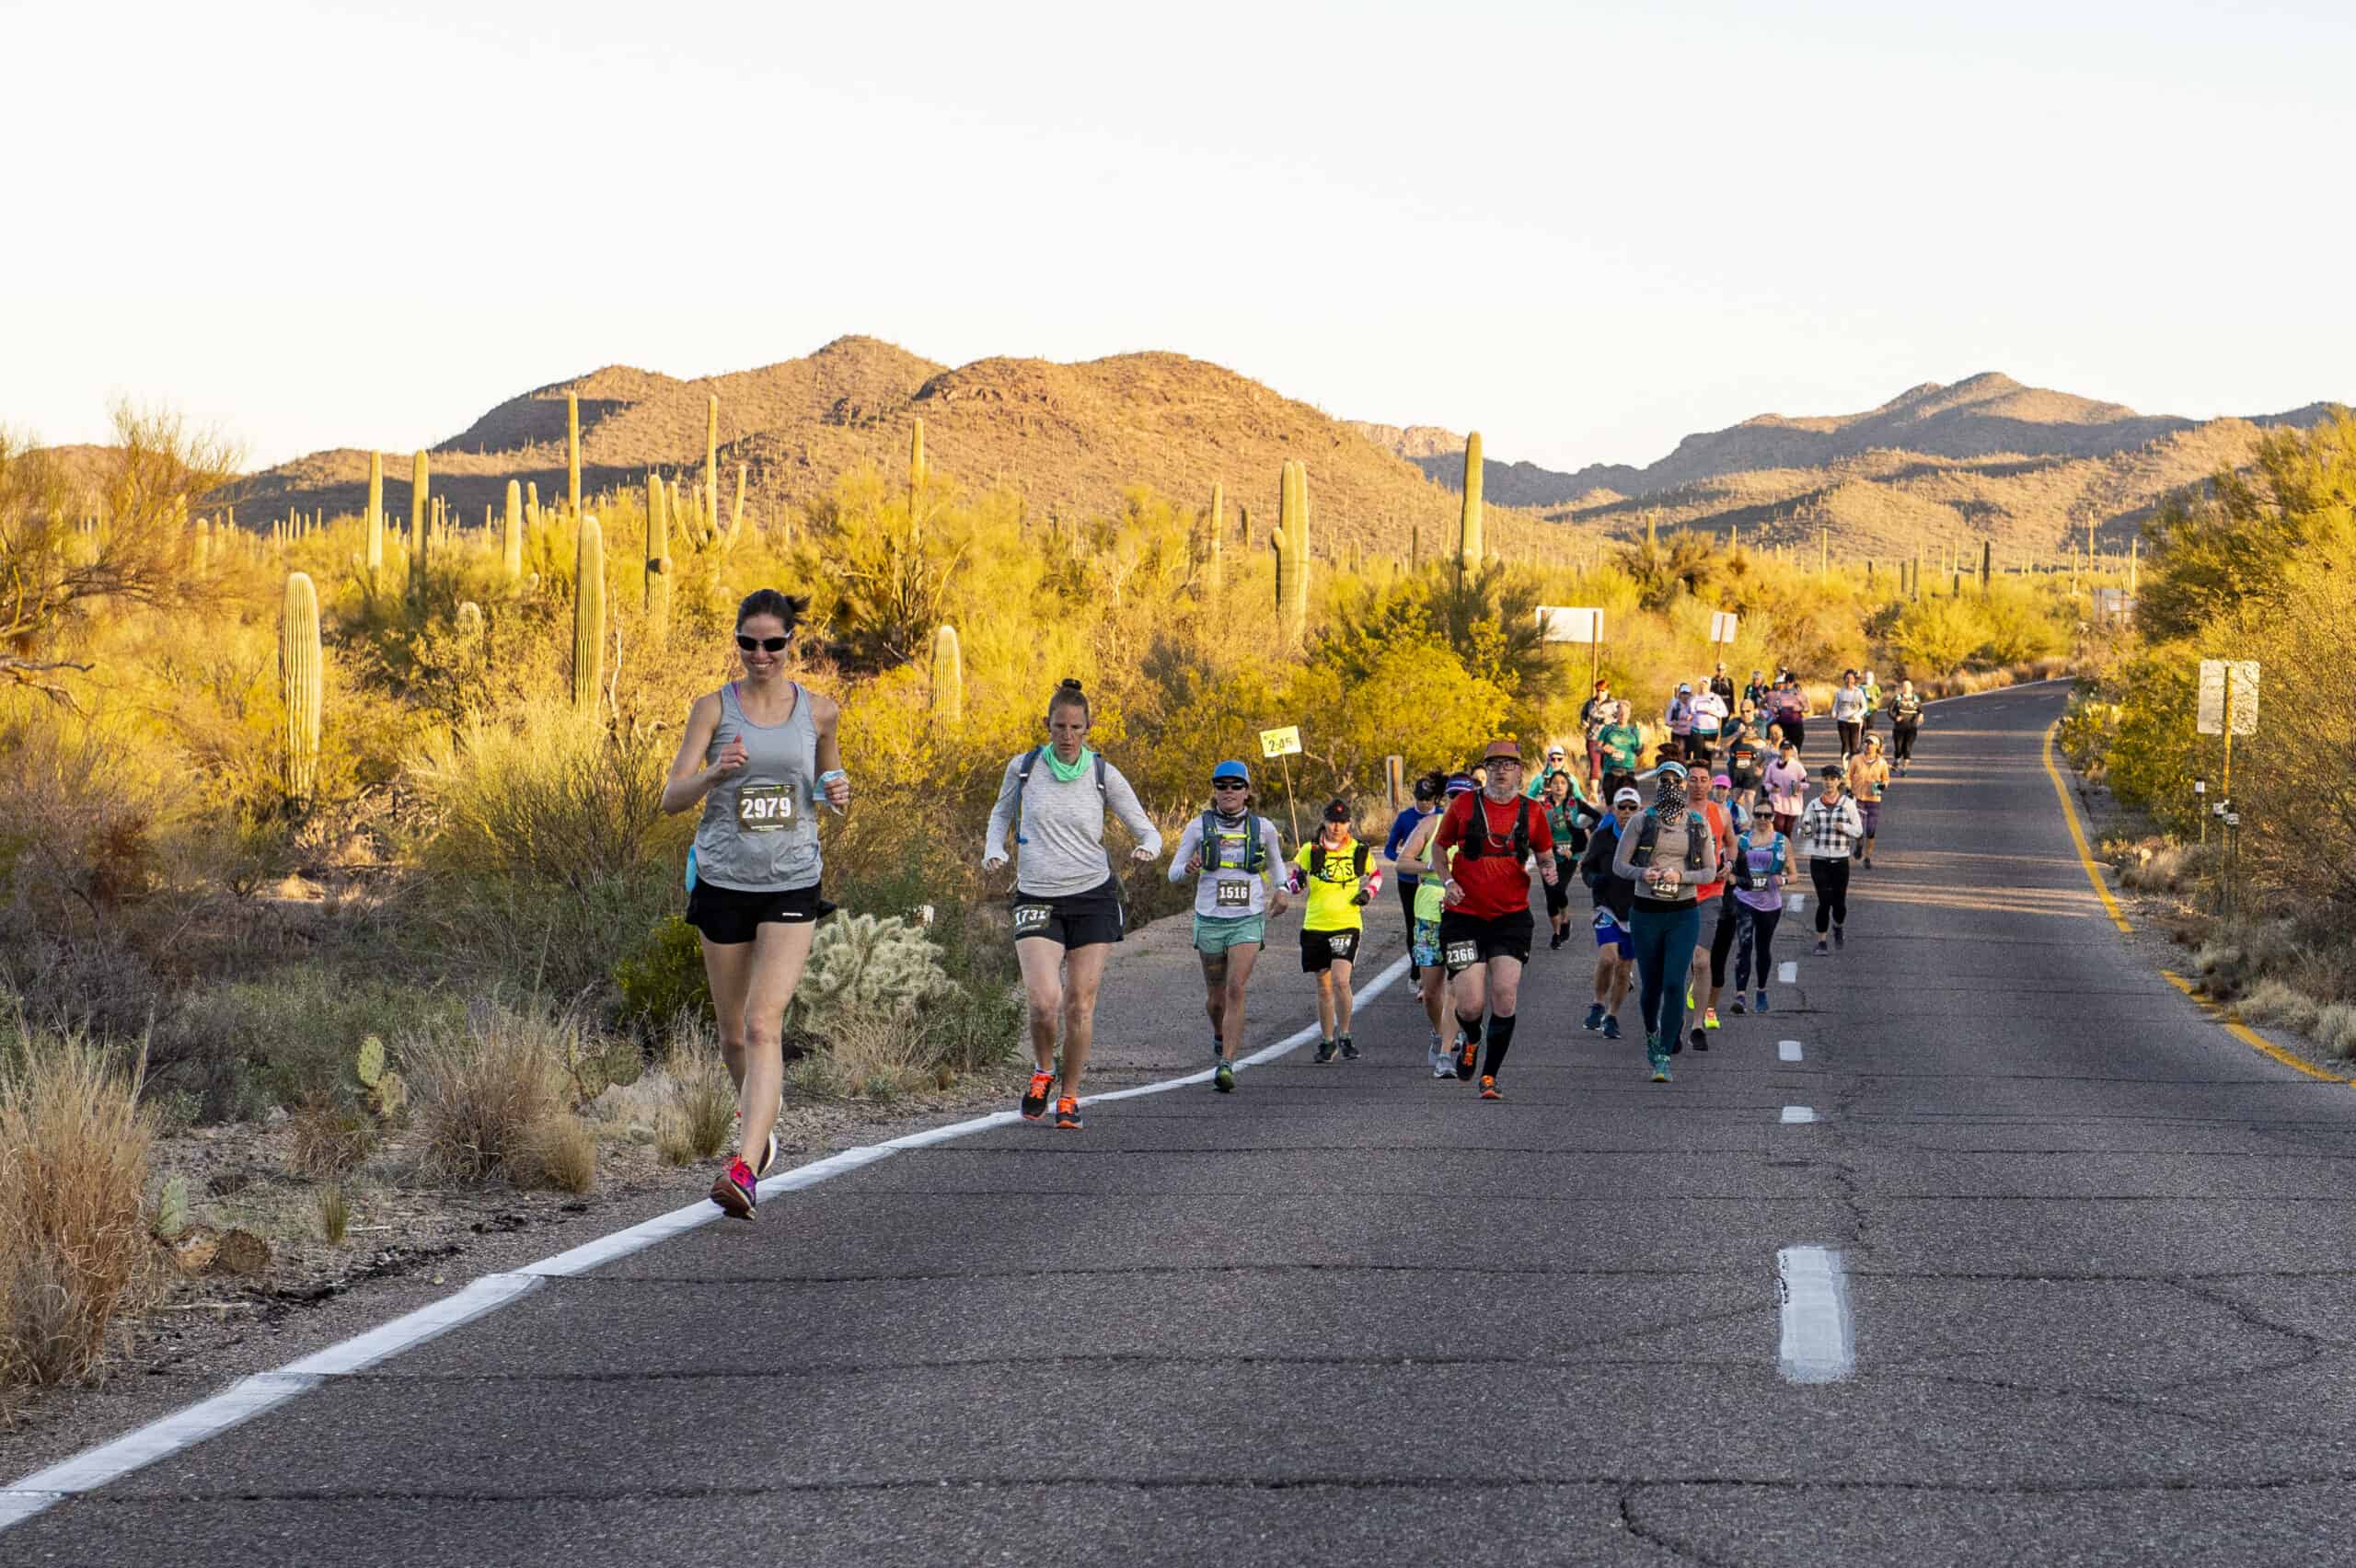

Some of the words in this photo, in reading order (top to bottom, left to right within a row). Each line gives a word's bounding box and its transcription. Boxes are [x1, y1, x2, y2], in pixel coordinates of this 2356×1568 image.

[740, 797, 791, 819] 2979
[1219, 886, 1248, 899] 1516
[1446, 948, 1474, 963] 2366
